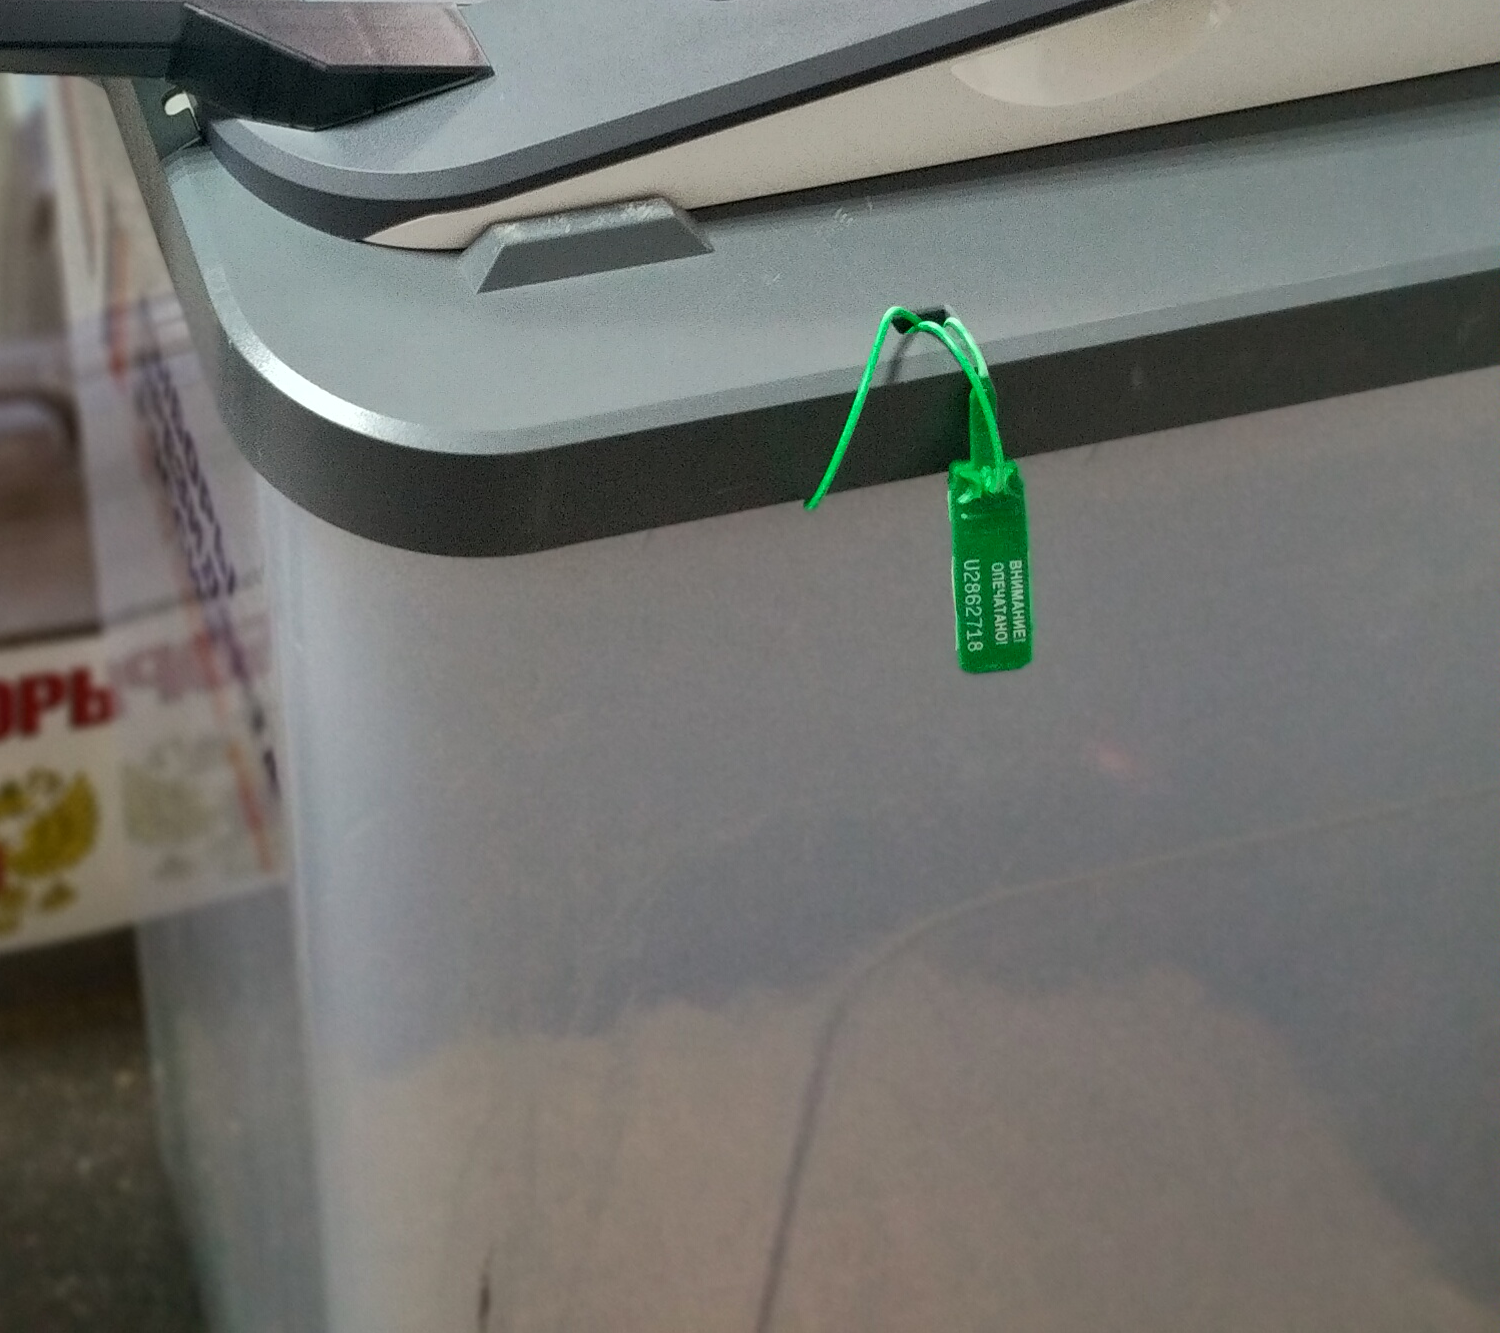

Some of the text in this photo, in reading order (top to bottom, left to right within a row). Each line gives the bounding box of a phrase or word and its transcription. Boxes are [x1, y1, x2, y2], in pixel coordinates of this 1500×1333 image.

[963, 558, 984, 652] U2862718
[991, 561, 1008, 645] ОПЕЧАТАНО!
[1009, 560, 1027, 642] ВНИМАНИЕ!
